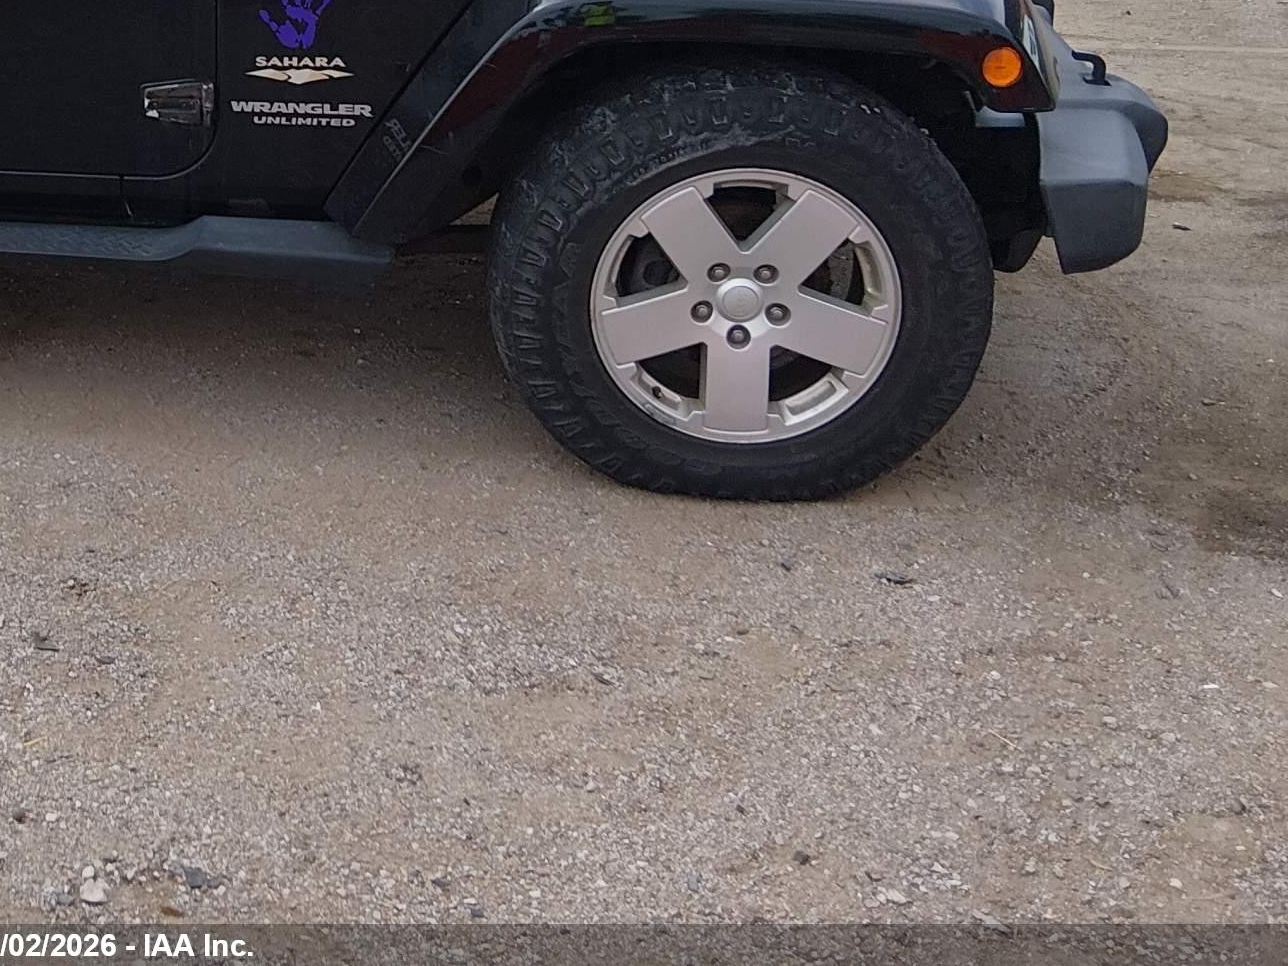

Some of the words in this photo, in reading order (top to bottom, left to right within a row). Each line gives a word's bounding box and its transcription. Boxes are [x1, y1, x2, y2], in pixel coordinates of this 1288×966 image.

[255, 56, 347, 68] SAHARA
[230, 100, 374, 118] WRANGLER
[253, 116, 356, 128] UNLIMITED
